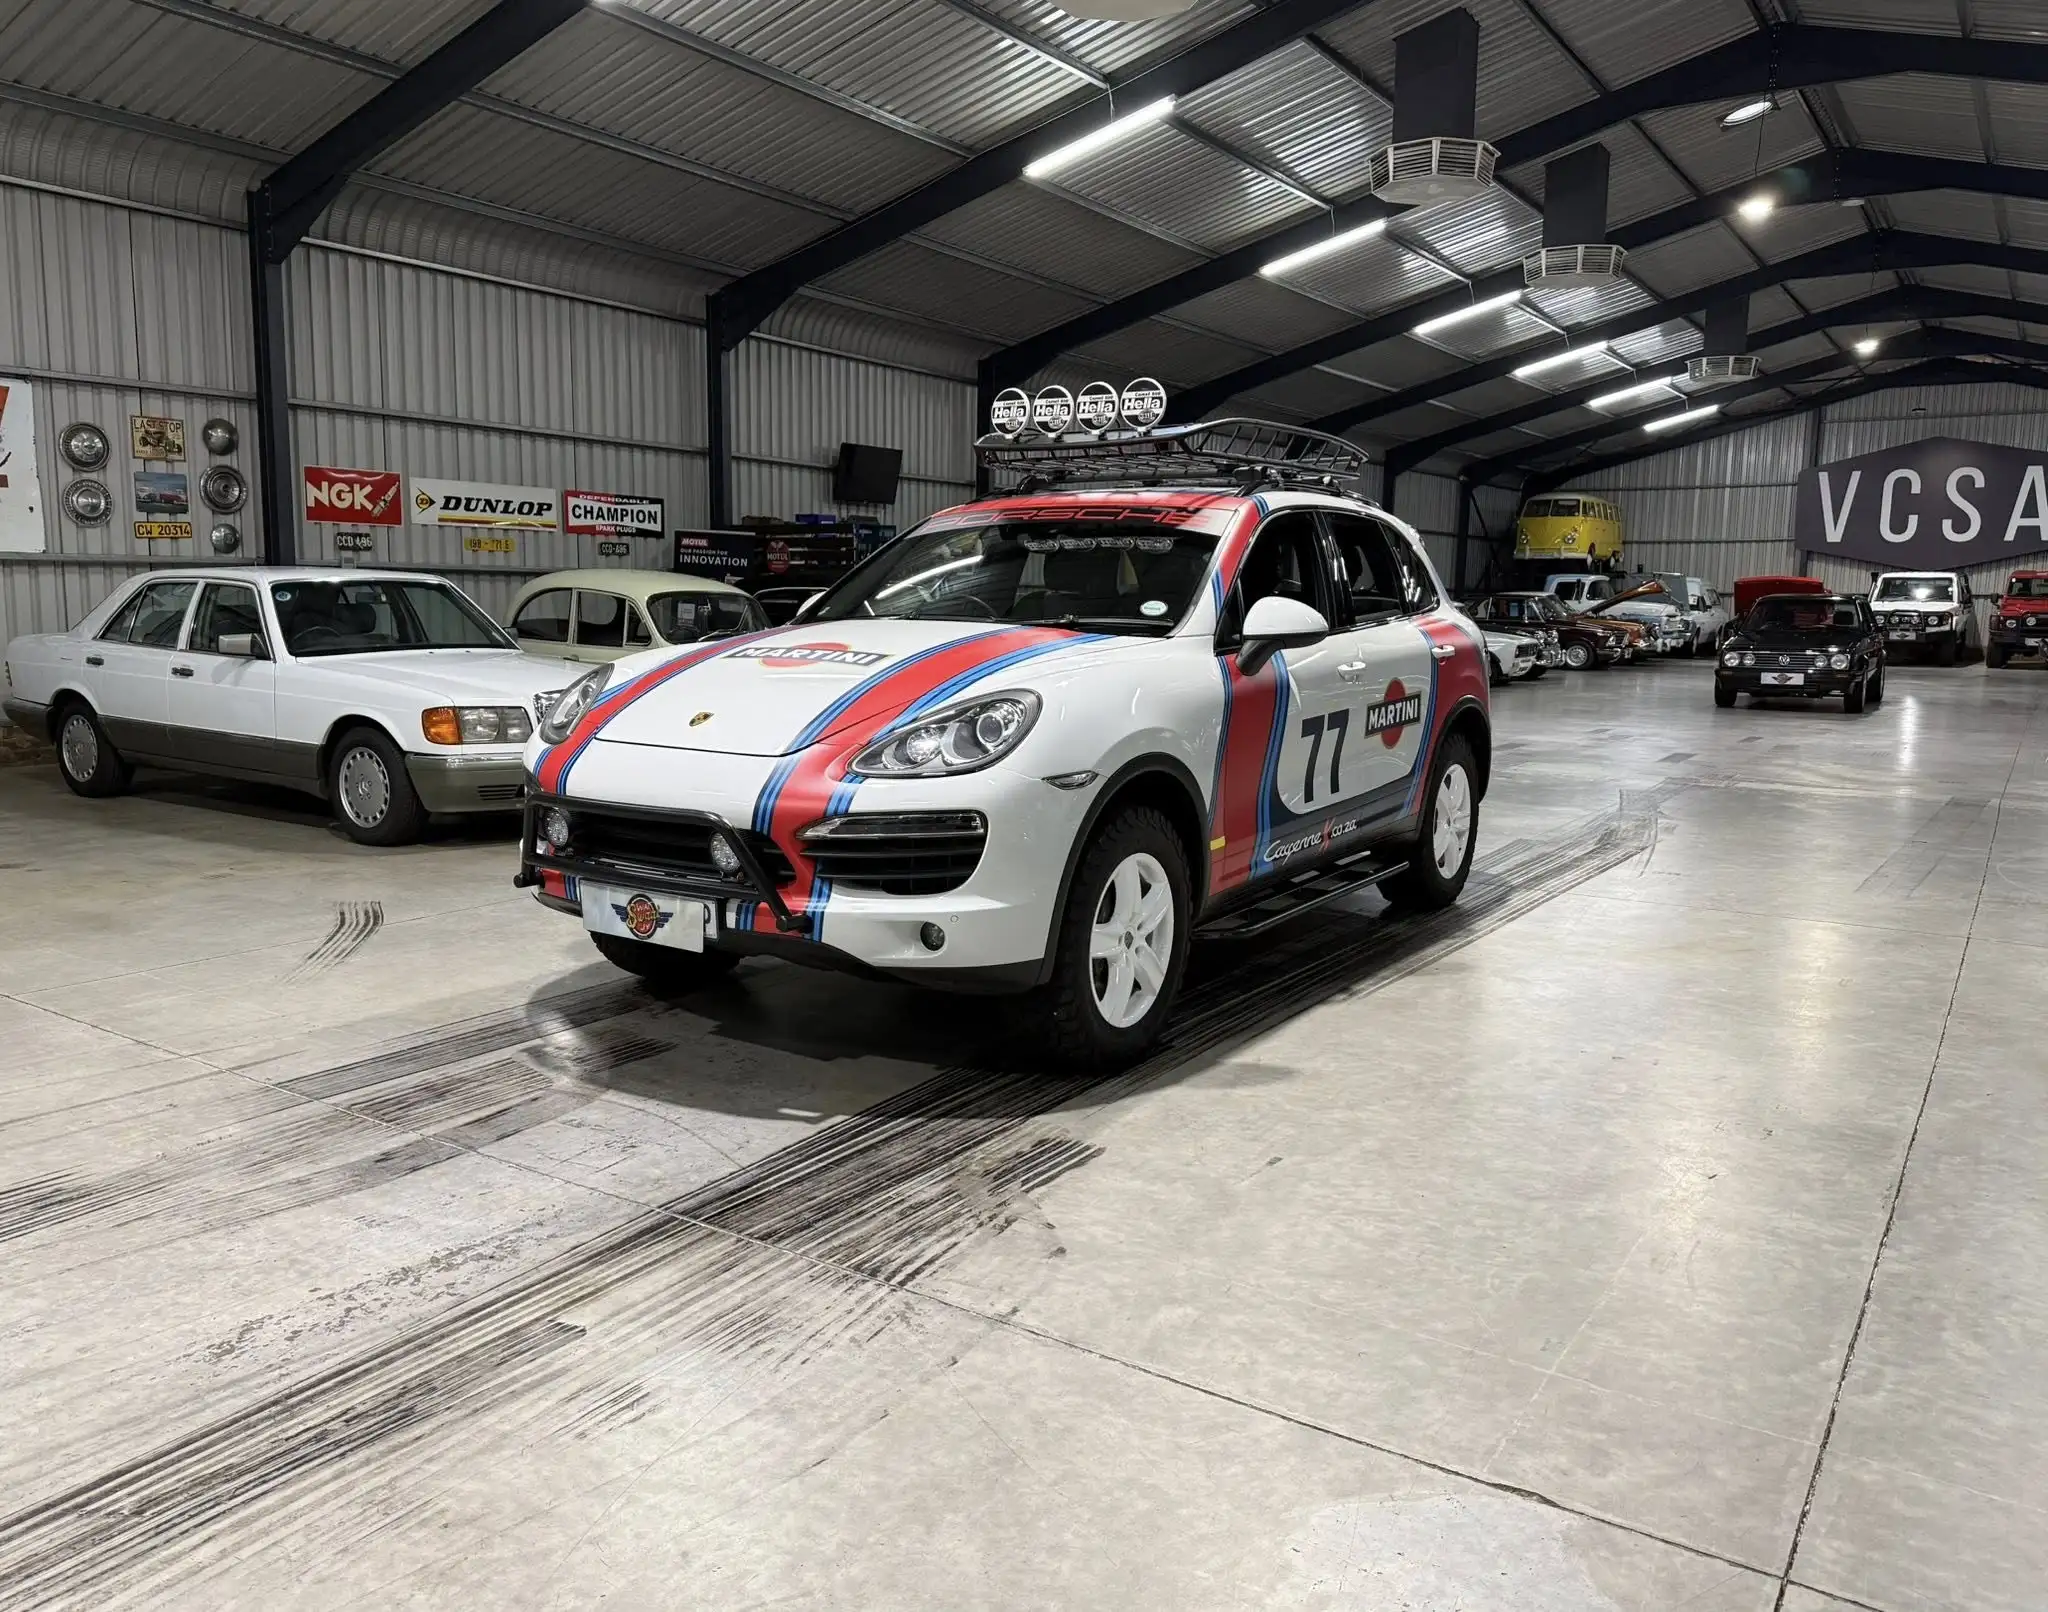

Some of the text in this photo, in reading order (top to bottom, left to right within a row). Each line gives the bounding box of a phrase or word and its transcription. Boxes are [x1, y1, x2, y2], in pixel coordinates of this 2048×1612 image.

[1079, 401, 1113, 413] Hella
[1123, 397, 1161, 410] Hella
[993, 406, 1025, 418] Hella
[1036, 405, 1069, 417] Hella
[133, 419, 182, 433] LAST STOP
[306, 480, 374, 512] NGK
[580, 494, 650, 505] DEPENDABLE
[440, 495, 553, 516] DUNLOP
[1818, 465, 2048, 543] VCSA
[572, 504, 658, 524] CHAMPION
[923, 508, 1210, 530] PORSCHE
[137, 524, 191, 536] CW 20314
[616, 525, 636, 533] PLUGS
[681, 538, 708, 547] MOTUL
[680, 554, 748, 567] INNOVATION
[767, 552, 788, 561] MOTUL
[736, 648, 879, 664] MARTINI
[1369, 698, 1419, 730] MARTINI
[1301, 708, 1350, 804] 77
